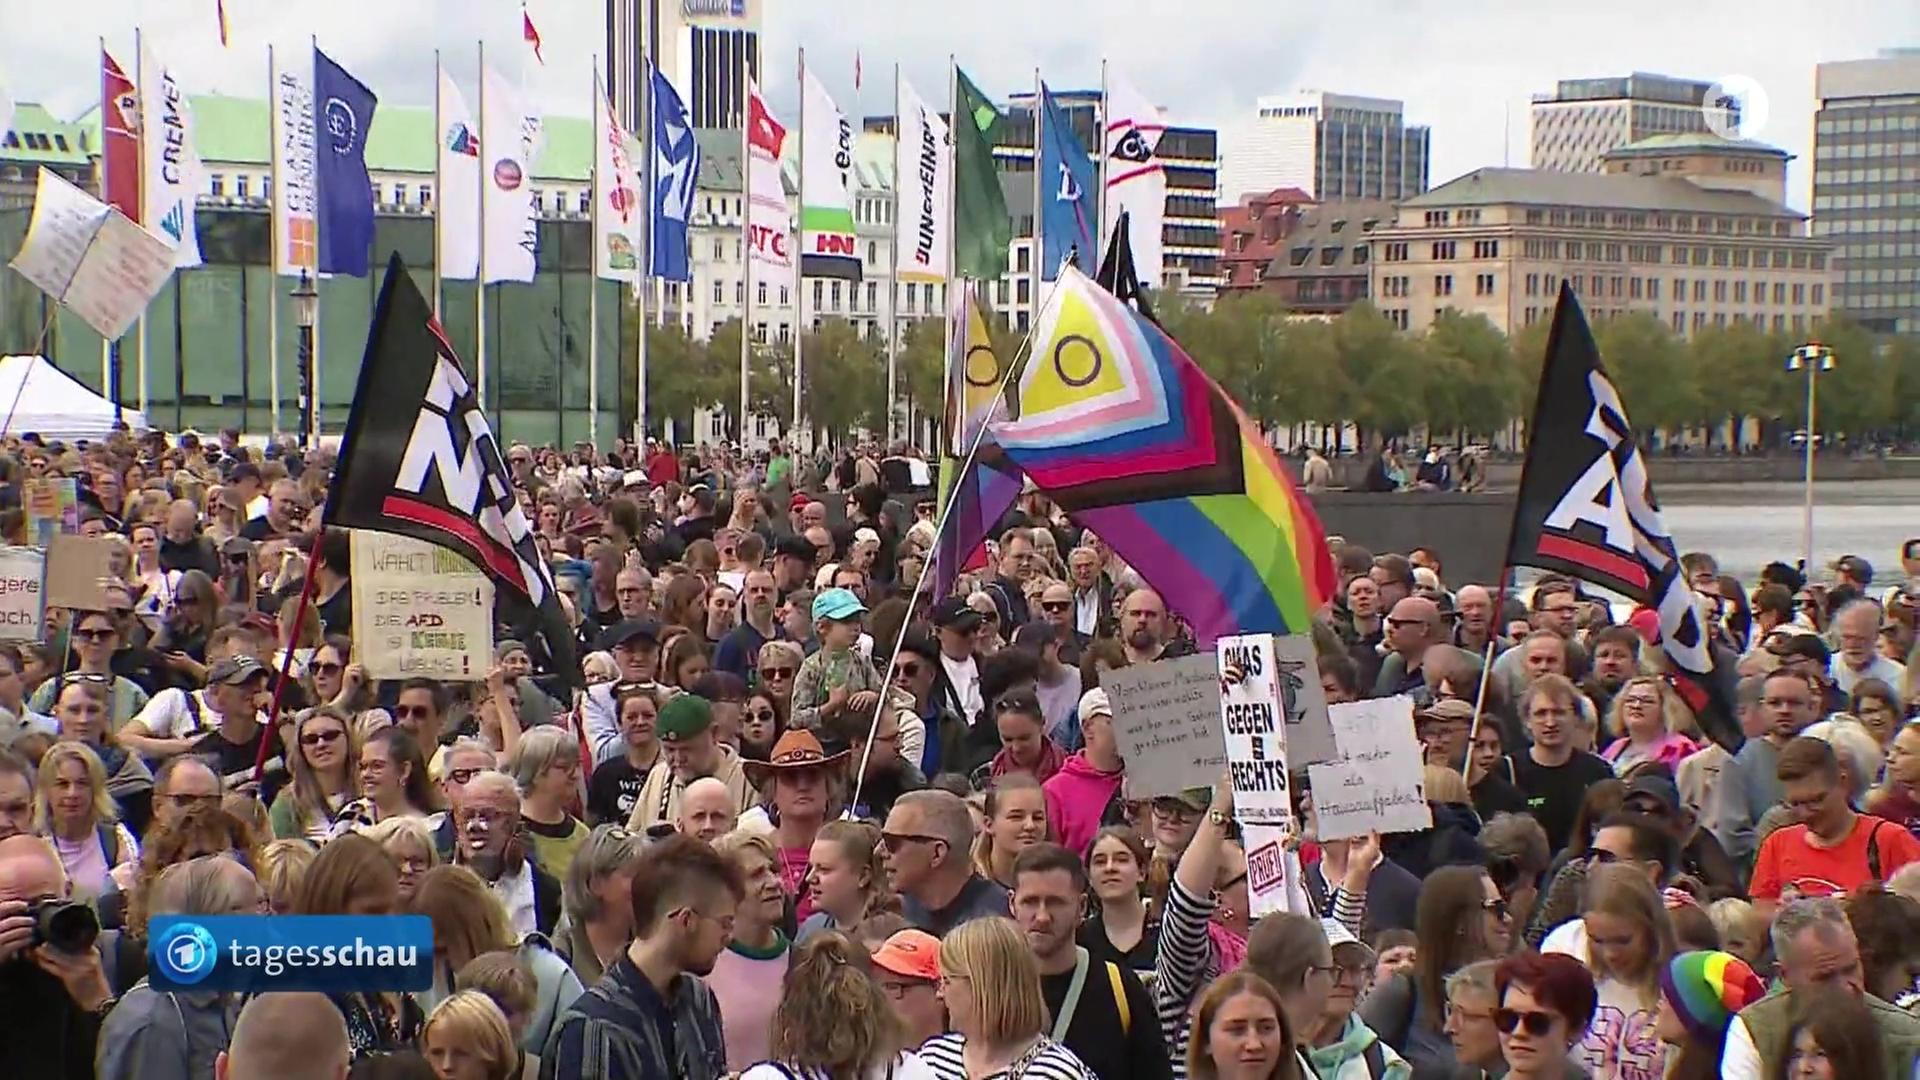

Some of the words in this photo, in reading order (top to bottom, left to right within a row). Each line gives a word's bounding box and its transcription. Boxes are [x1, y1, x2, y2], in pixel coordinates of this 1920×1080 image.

[405, 613, 443, 627] AFD
[1226, 703, 1274, 735] GEGEN
[1231, 760, 1286, 792] RECHTS
